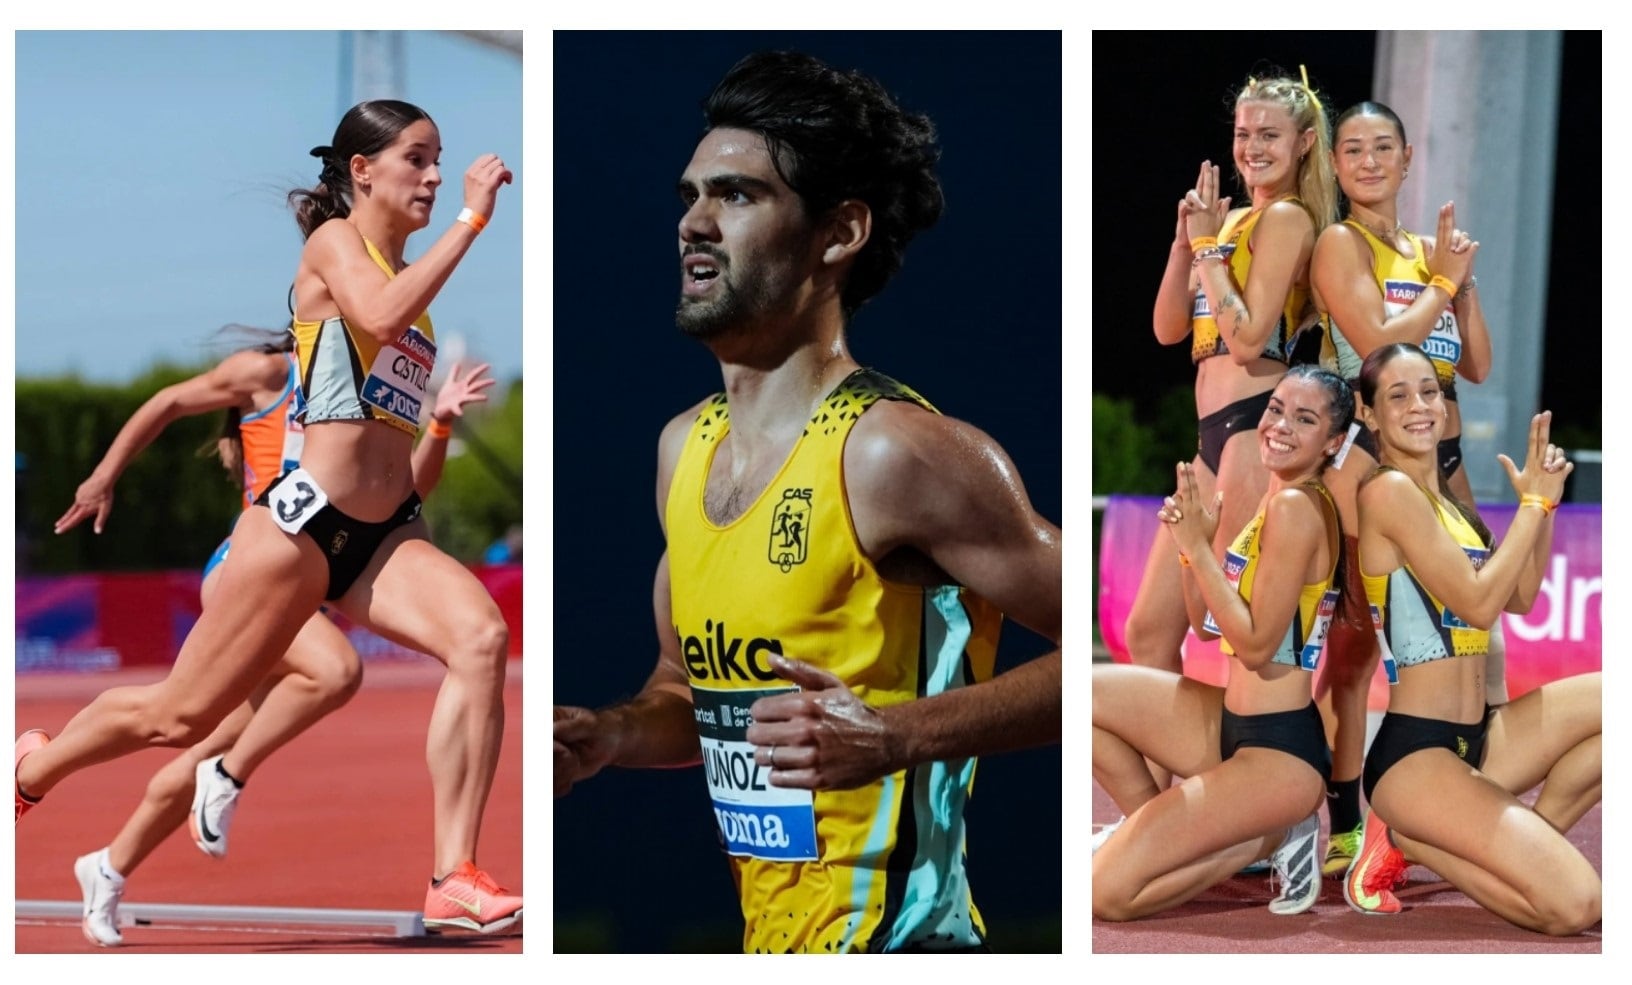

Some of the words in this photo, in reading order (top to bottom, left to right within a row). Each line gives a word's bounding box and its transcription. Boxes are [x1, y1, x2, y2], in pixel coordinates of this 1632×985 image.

[1423, 340, 1456, 359] oma
[277, 481, 316, 523] 3
[783, 487, 813, 499] CAS
[1506, 554, 1602, 641] dr
